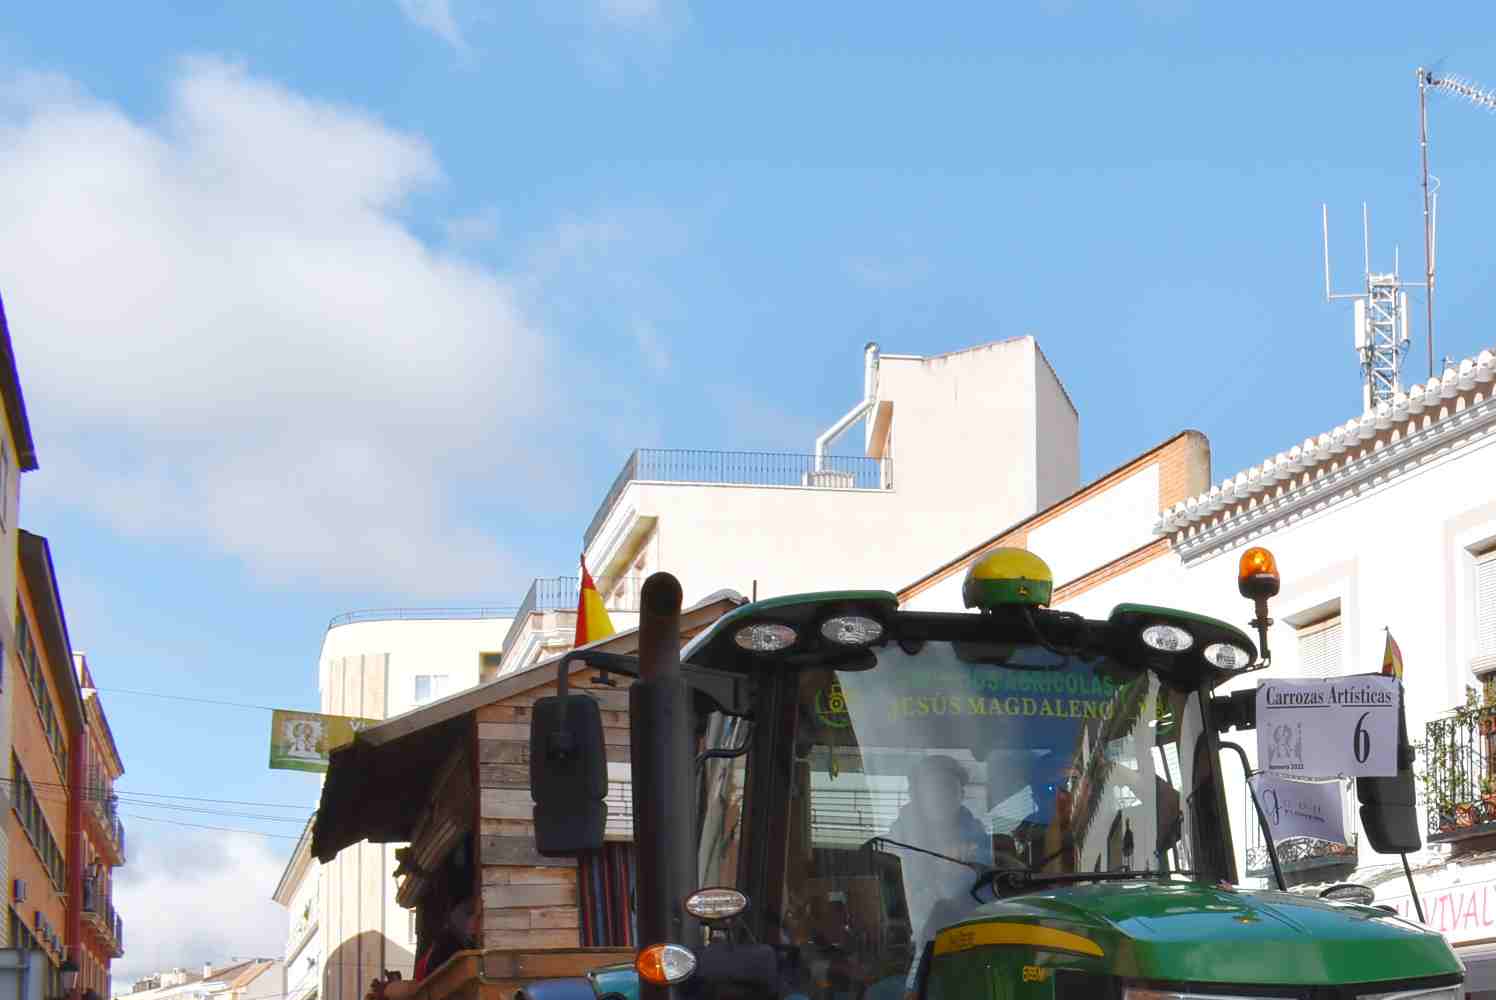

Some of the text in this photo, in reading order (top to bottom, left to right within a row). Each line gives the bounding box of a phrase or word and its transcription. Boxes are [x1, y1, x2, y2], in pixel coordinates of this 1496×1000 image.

[1266, 685, 1392, 706] Carrozas Artísticas
[967, 697, 1114, 720] MAGDALENO
[1353, 711, 1371, 764] 6
